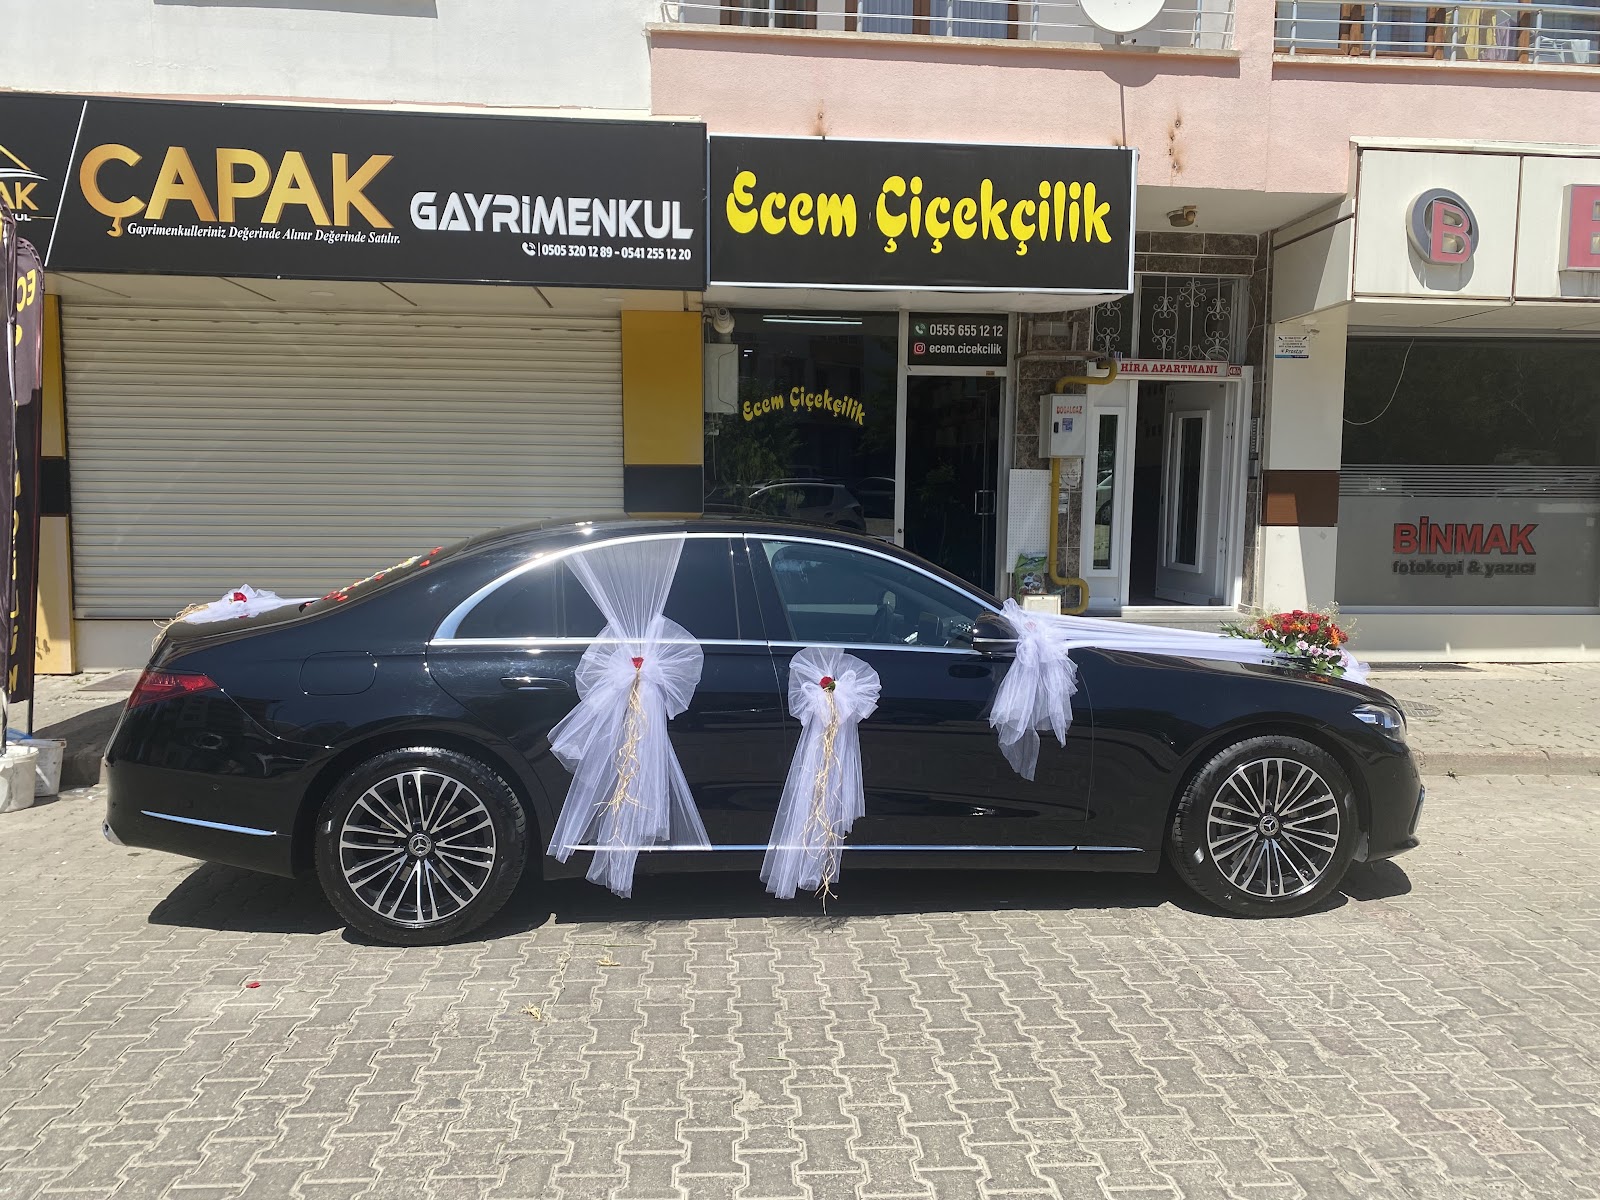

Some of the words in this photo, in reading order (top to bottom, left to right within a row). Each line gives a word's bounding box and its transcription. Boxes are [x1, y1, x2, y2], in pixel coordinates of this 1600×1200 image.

[79, 143, 395, 238] ÇAPAK
[726, 170, 857, 238] Ecem
[875, 175, 1112, 256] Çiçekçilik
[127, 222, 226, 238] Gayrimenkulleriniz
[228, 226, 281, 241] Değerinde
[282, 228, 312, 240] Alınır
[315, 229, 366, 244] Değerinde
[367, 232, 400, 244] Satılır.
[541, 244, 567, 257] 0505
[568, 245, 586, 257] 320
[587, 246, 599, 257] 12
[600, 246, 613, 258] 89
[621, 247, 645, 259] 0541
[646, 248, 664, 260] 255
[666, 249, 677, 260] 12
[678, 249, 692, 260] 20
[930, 324, 956, 336] 0555
[958, 325, 977, 336] 655
[979, 325, 990, 337] 12
[993, 325, 1003, 337] 12
[929, 342, 1002, 355] ecem.cicekcilik
[1120, 362, 1149, 373] HİRA
[1151, 364, 1218, 374] APARTMANI
[742, 394, 784, 422] Ecem
[789, 386, 866, 426] Çiçekçilik
[1393, 516, 1539, 555] BİNMAK
[1392, 559, 1464, 578] fotokopi
[1467, 560, 1480, 574] &
[1484, 561, 1536, 578] yazıcı
